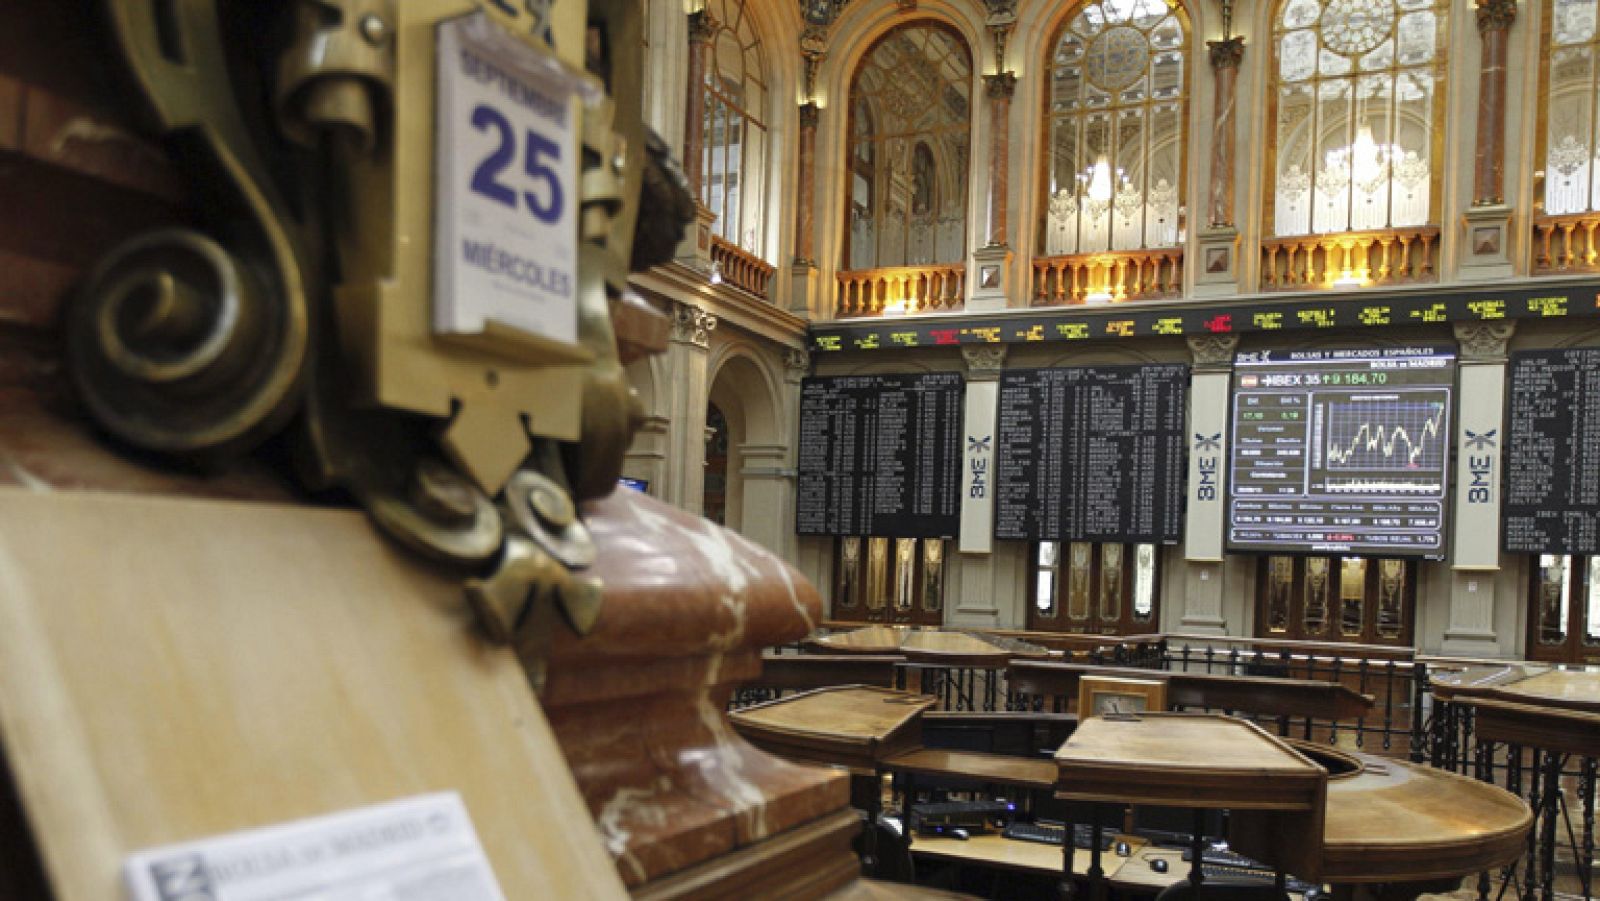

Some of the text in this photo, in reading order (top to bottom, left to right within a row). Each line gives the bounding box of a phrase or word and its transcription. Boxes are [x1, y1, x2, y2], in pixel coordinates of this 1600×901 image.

[469, 103, 564, 226] 25
[462, 238, 571, 298] MIÉRCOLES
[1305, 373, 1321, 385] 35
